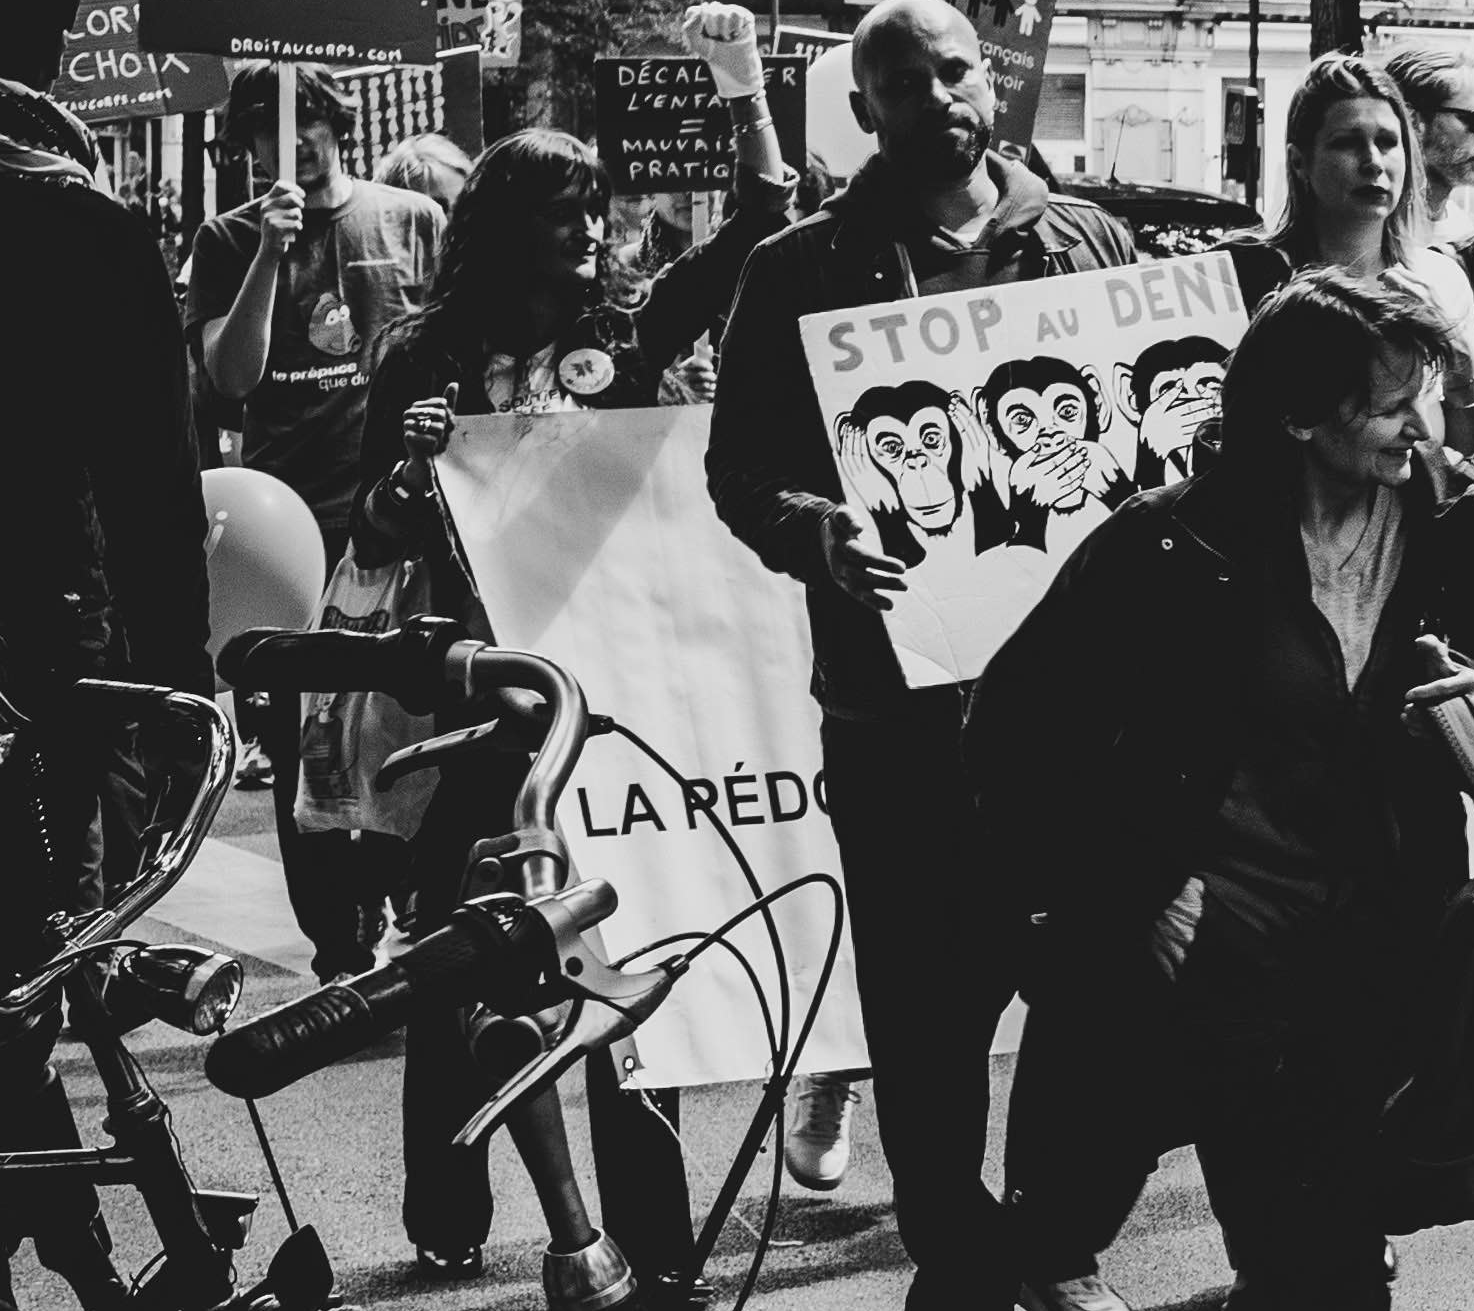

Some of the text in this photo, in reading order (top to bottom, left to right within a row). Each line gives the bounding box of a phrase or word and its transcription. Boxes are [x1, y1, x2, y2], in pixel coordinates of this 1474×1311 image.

[627, 92, 730, 112] L'ENFA
[828, 296, 1003, 374] STOP
[1036, 307, 1081, 344] AU
[576, 783, 667, 838] LA
